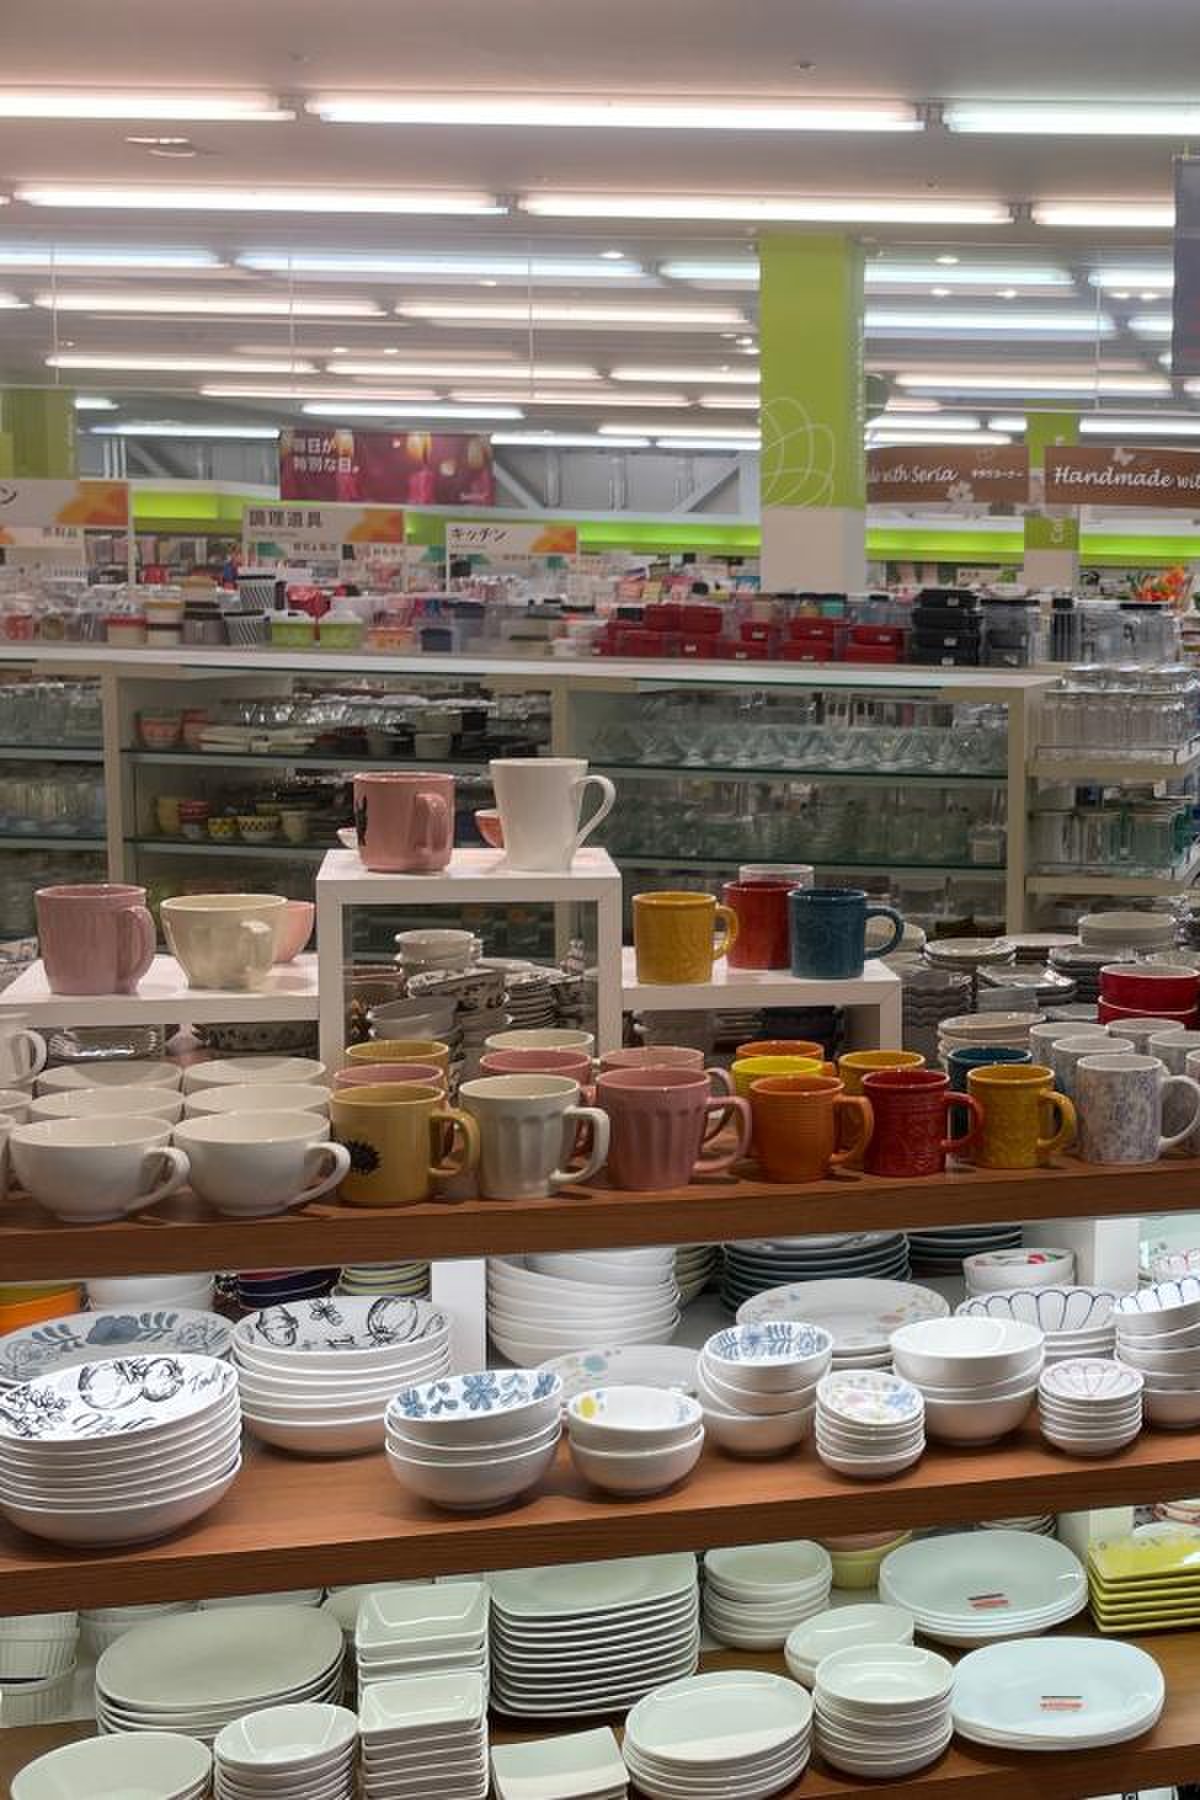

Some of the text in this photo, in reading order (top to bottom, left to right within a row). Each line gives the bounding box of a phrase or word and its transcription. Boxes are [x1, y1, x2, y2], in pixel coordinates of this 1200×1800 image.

[1055, 465, 1170, 488] Handmade
[451, 527, 508, 543] キッチン
